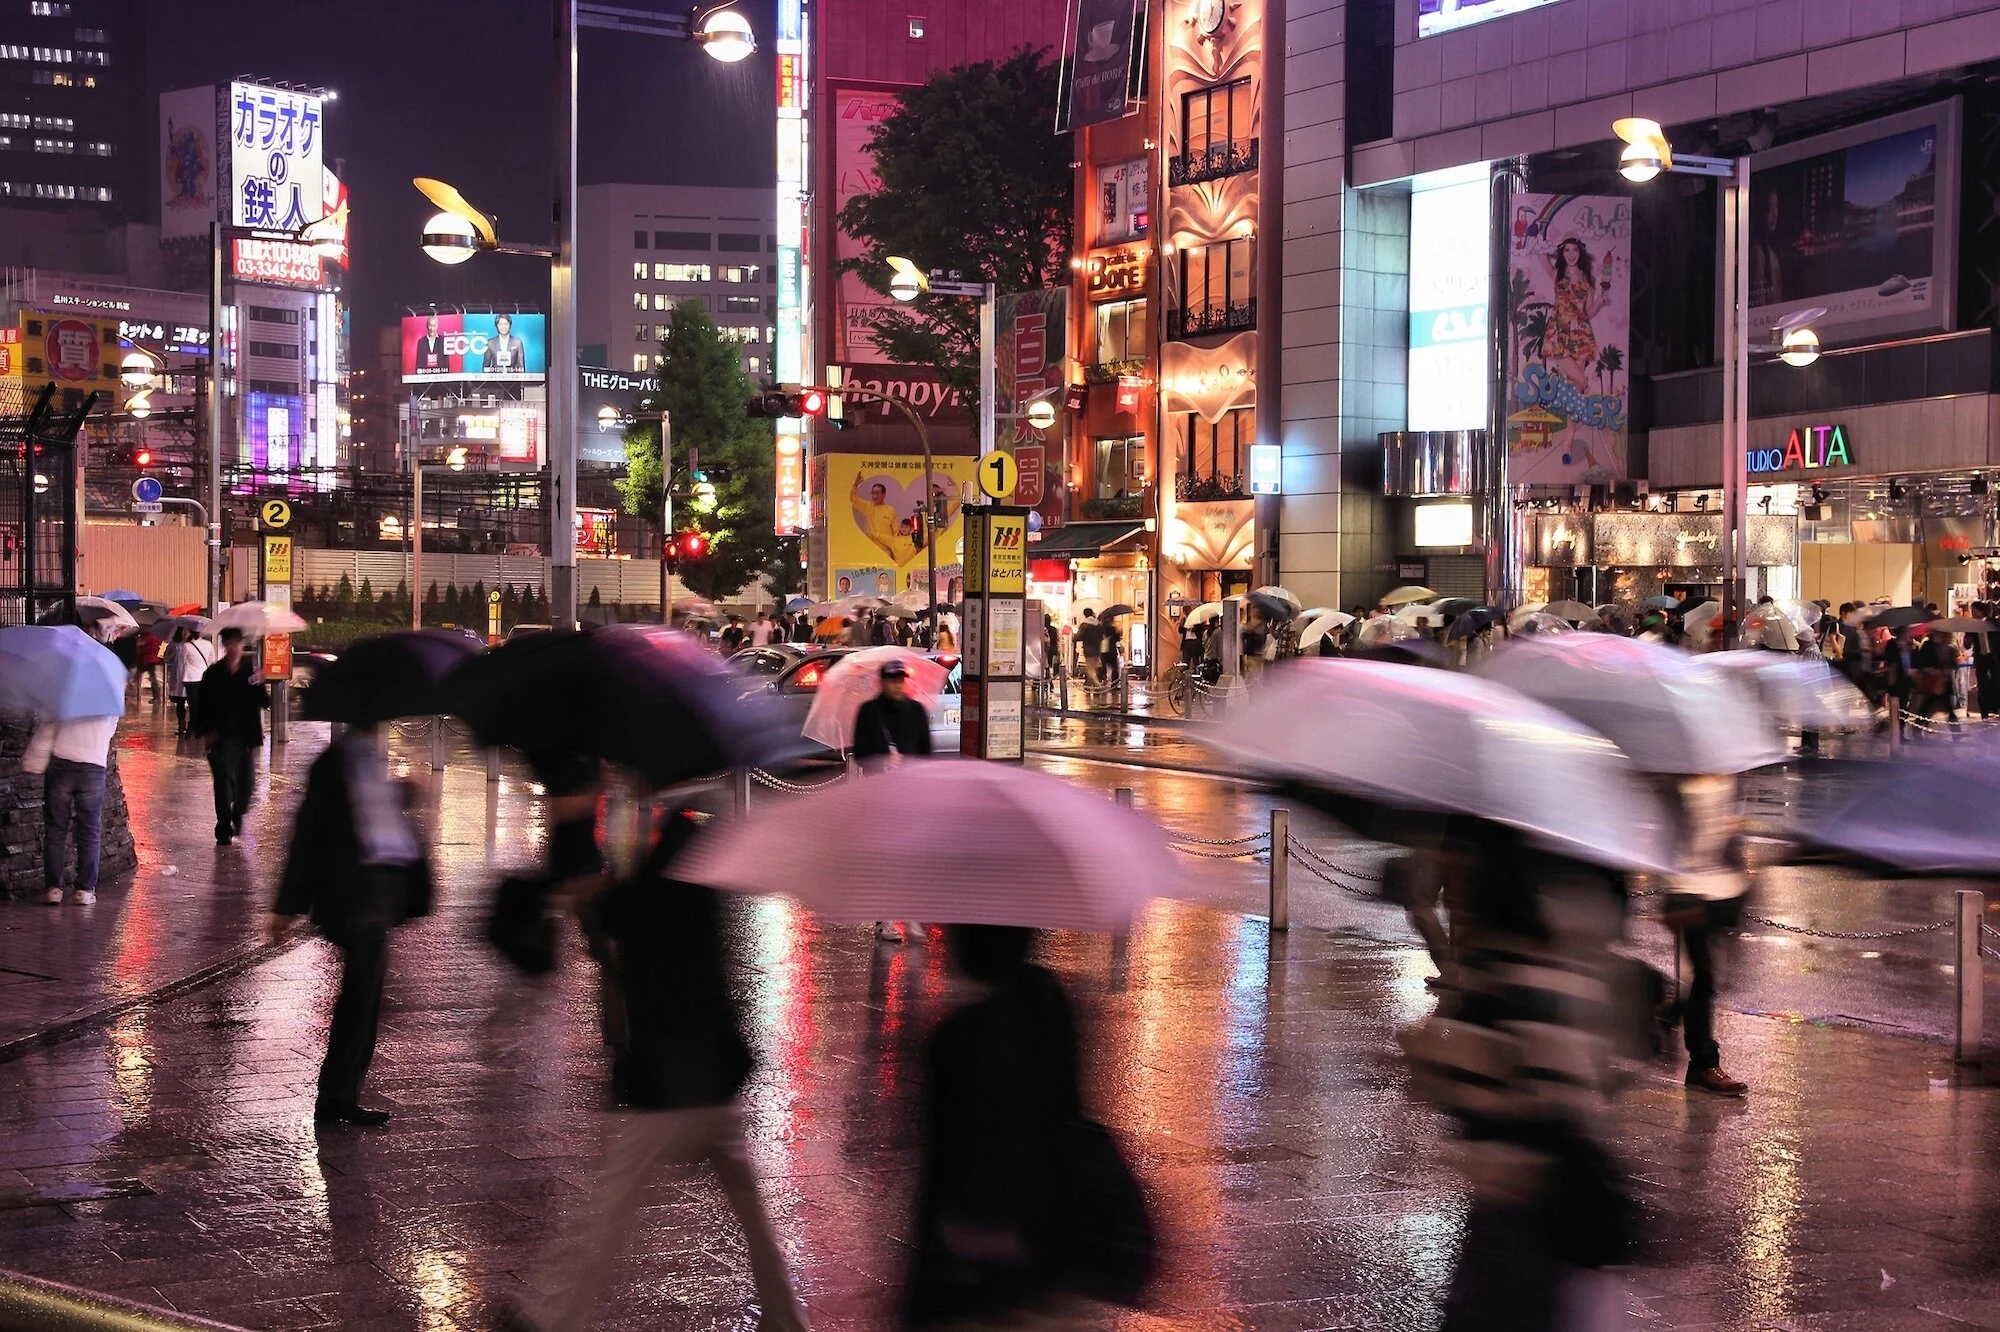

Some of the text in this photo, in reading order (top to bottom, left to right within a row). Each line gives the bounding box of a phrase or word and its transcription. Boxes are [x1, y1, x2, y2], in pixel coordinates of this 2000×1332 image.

[236, 87, 320, 158] カラオケ
[267, 148, 288, 185] の
[1114, 168, 1126, 182] 4F
[241, 174, 311, 230] 鉄人
[237, 258, 321, 282] 03-3345-6430
[57, 329, 92, 371] 質
[172, 327, 211, 345] コミッ
[443, 335, 489, 356] ECC
[1746, 425, 1849, 472] TUDIO ALTA
[990, 457, 1004, 492] 1
[264, 503, 284, 523] 2
[991, 568, 1023, 579] はとバス
